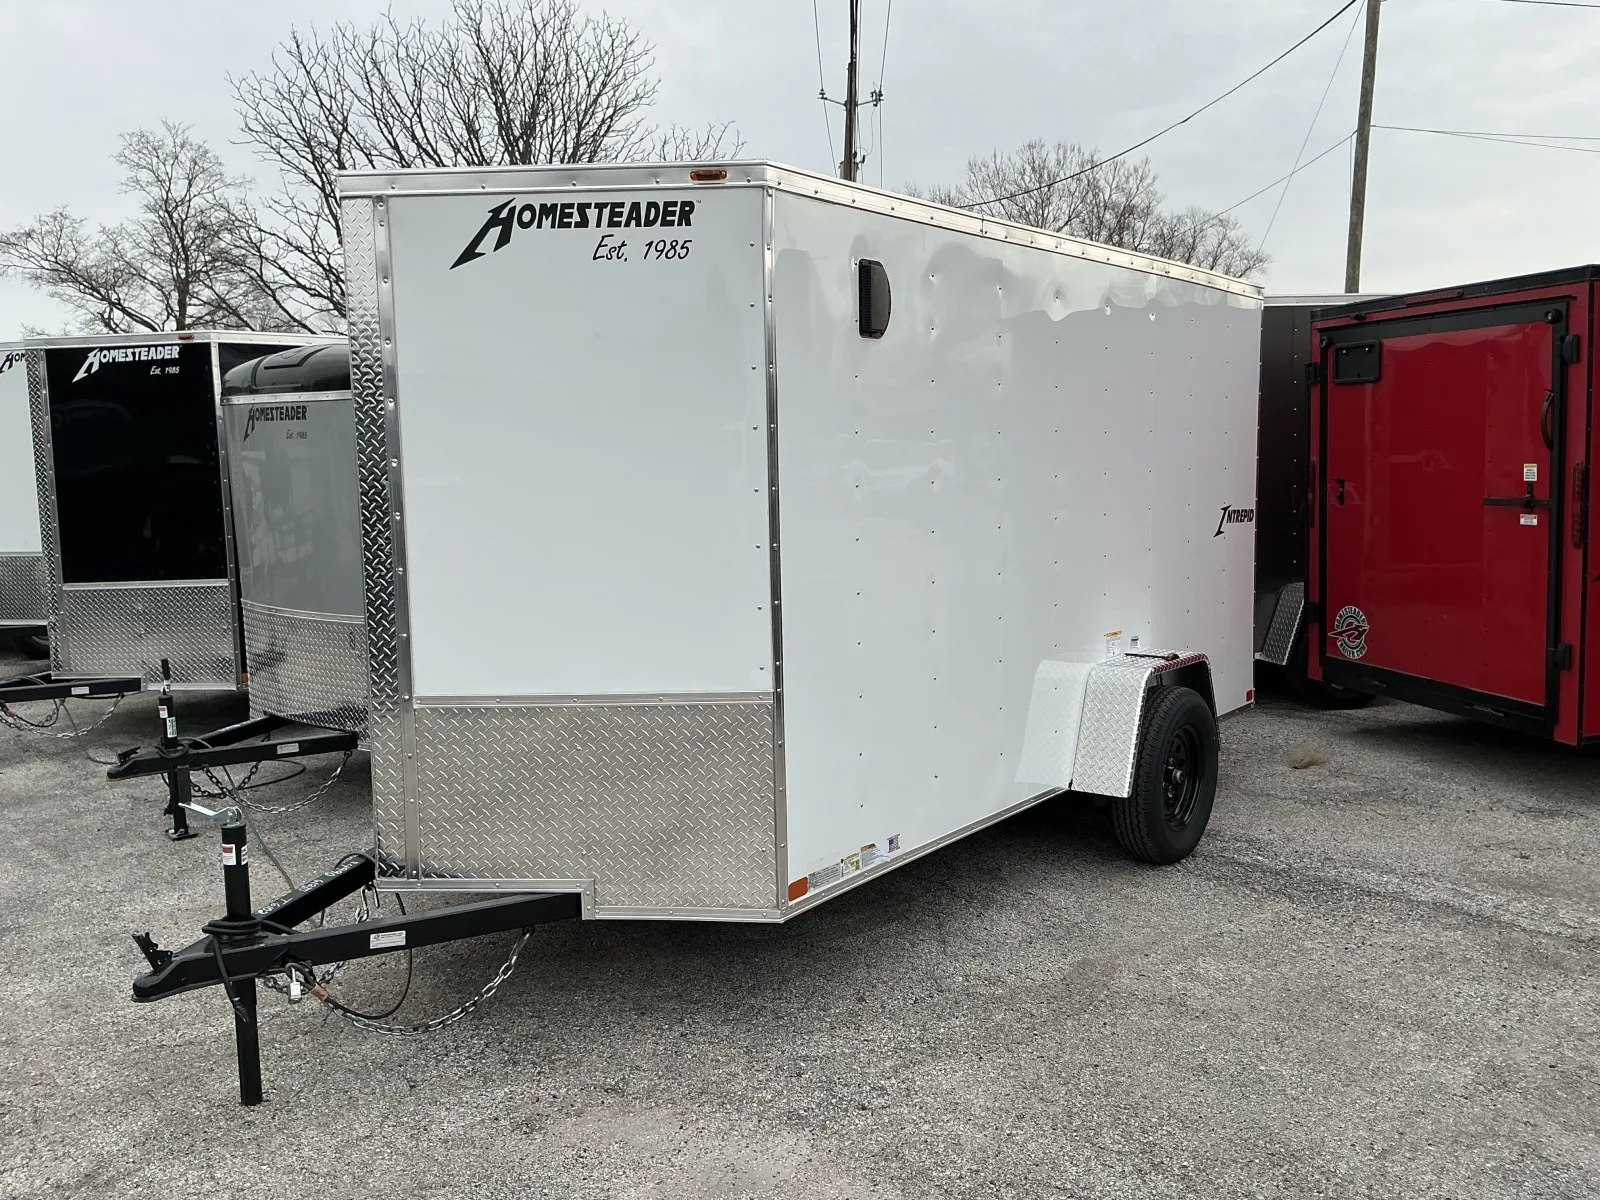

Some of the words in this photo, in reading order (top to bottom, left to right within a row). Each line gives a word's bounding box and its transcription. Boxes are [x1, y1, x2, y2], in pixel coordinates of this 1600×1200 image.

[449, 197, 695, 269] HOMESTEADER
[592, 234, 628, 262] Est.
[643, 239, 692, 261] 1985
[72, 346, 180, 383] HOMESTEADER
[165, 366, 180, 375] 1985
[243, 405, 307, 442] HOMESTEADER
[1213, 504, 1255, 538] INTREPID
